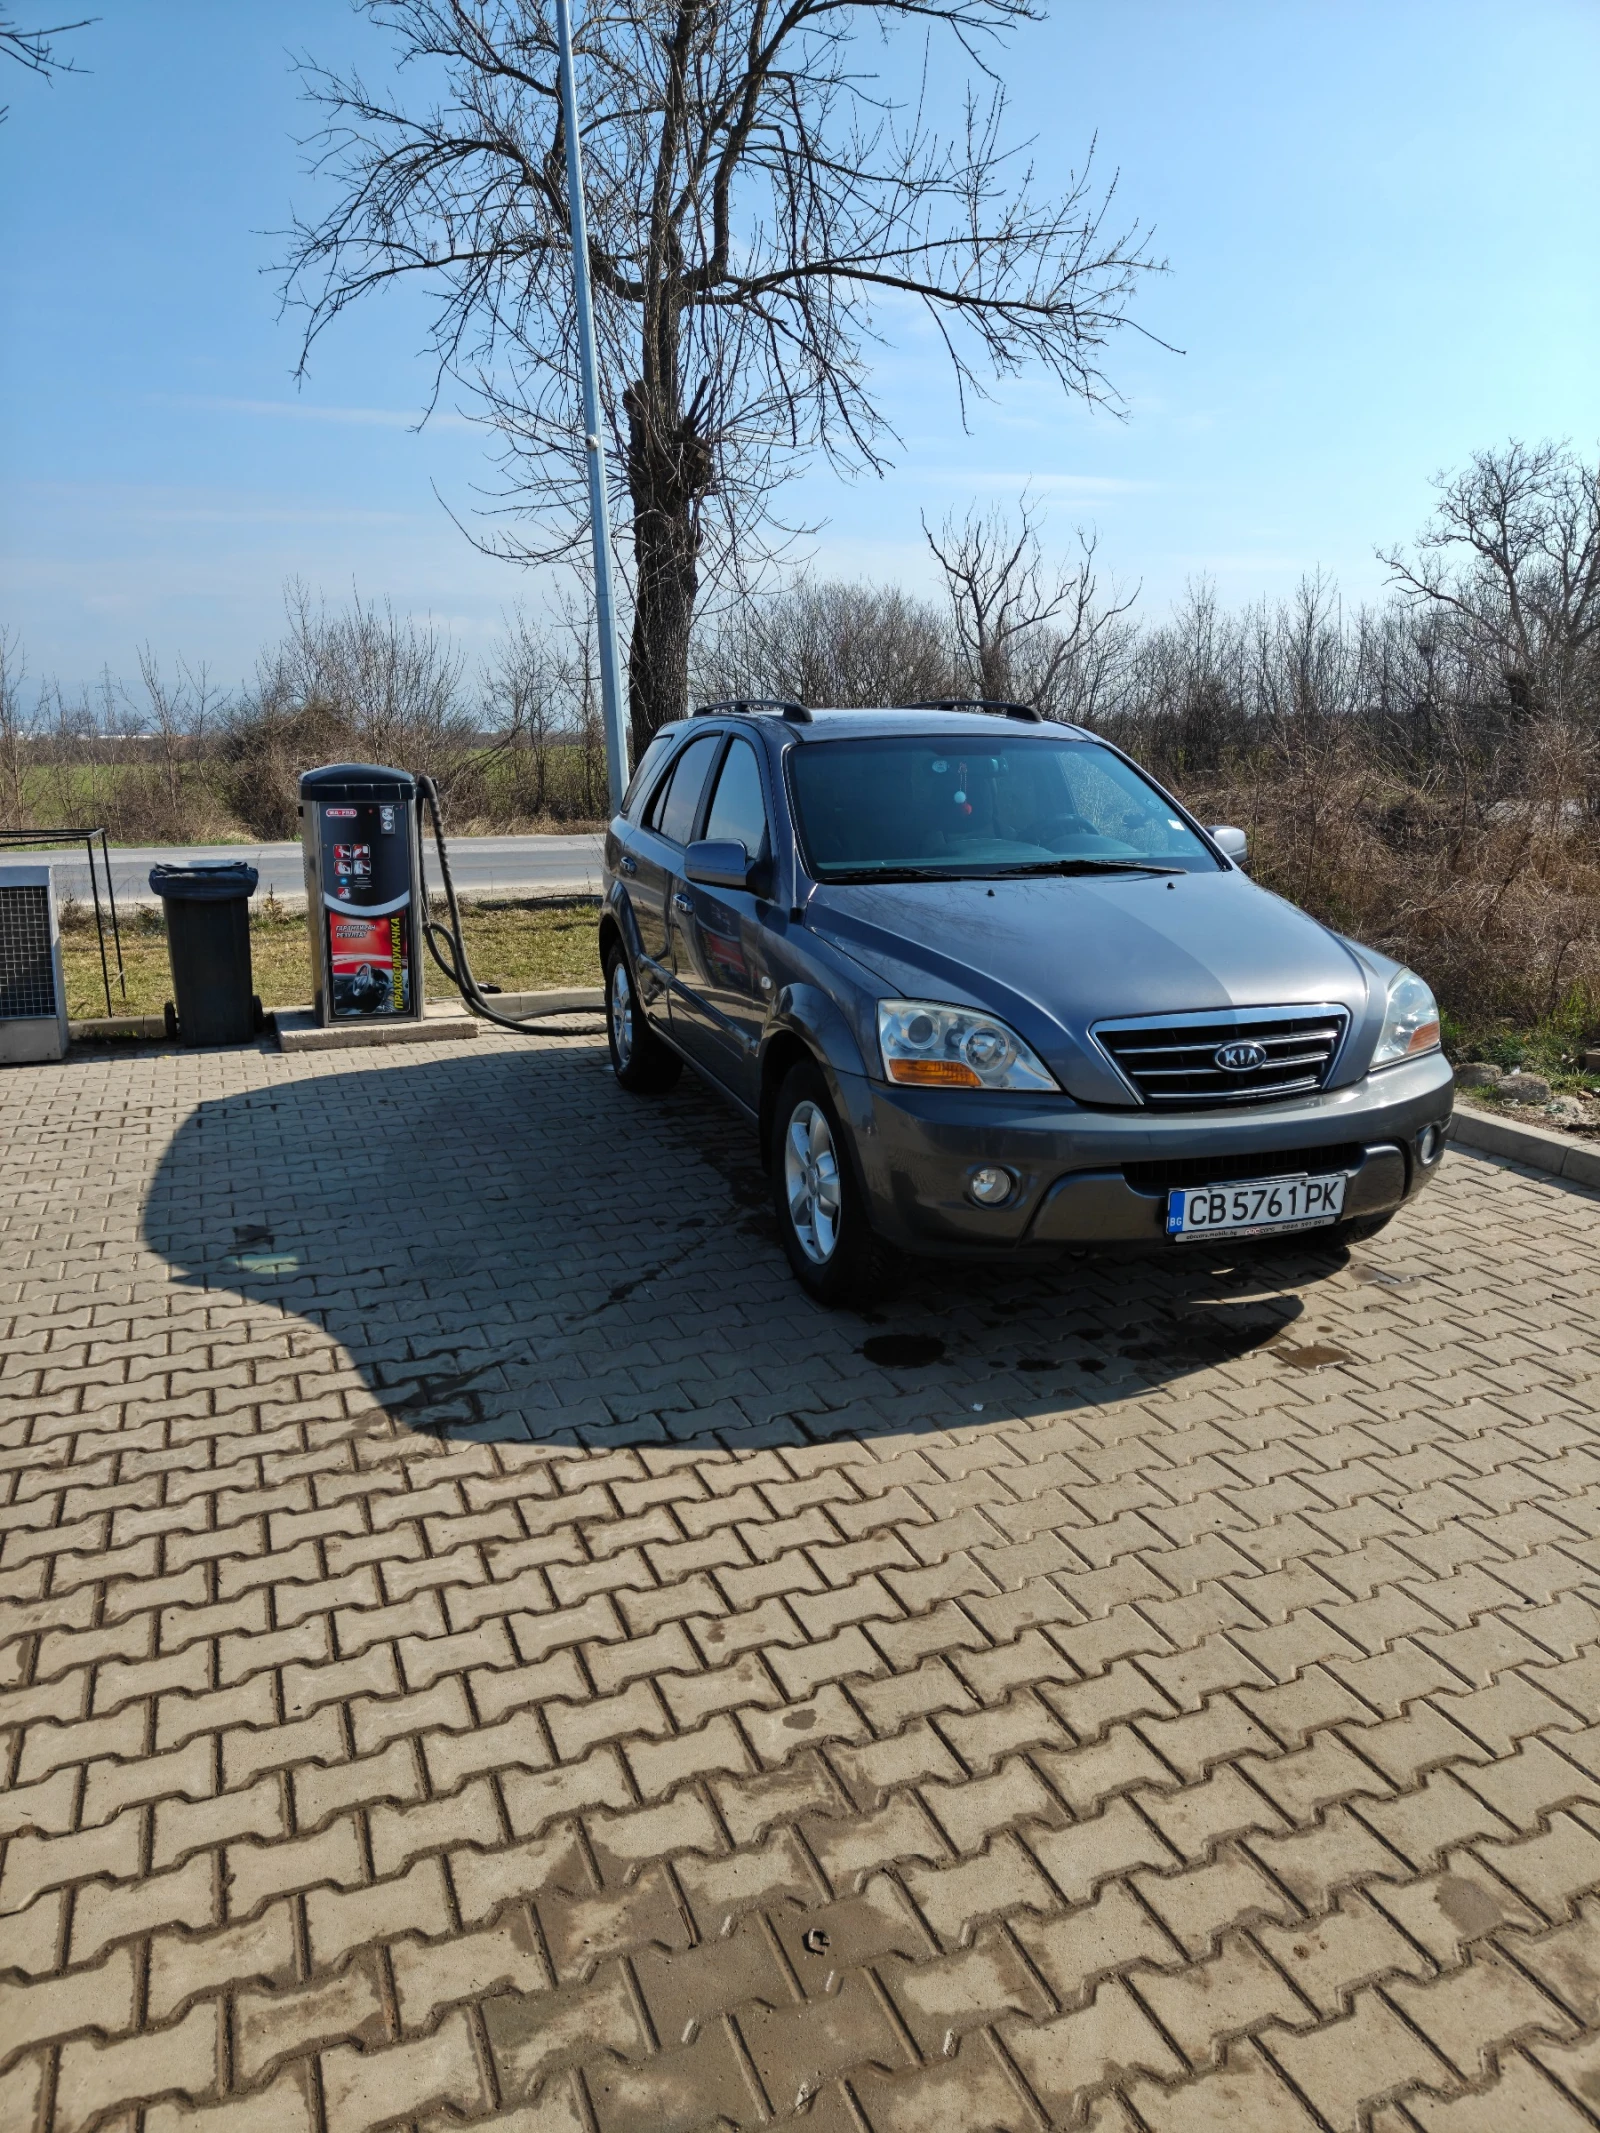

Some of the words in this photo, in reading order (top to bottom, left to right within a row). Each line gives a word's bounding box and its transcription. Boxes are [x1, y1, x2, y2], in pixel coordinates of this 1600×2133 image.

[391, 917, 403, 1009] ПРАХОСМУКАЧКА
[1225, 1048, 1259, 1066] KIA
[1169, 1217, 1182, 1227] BG
